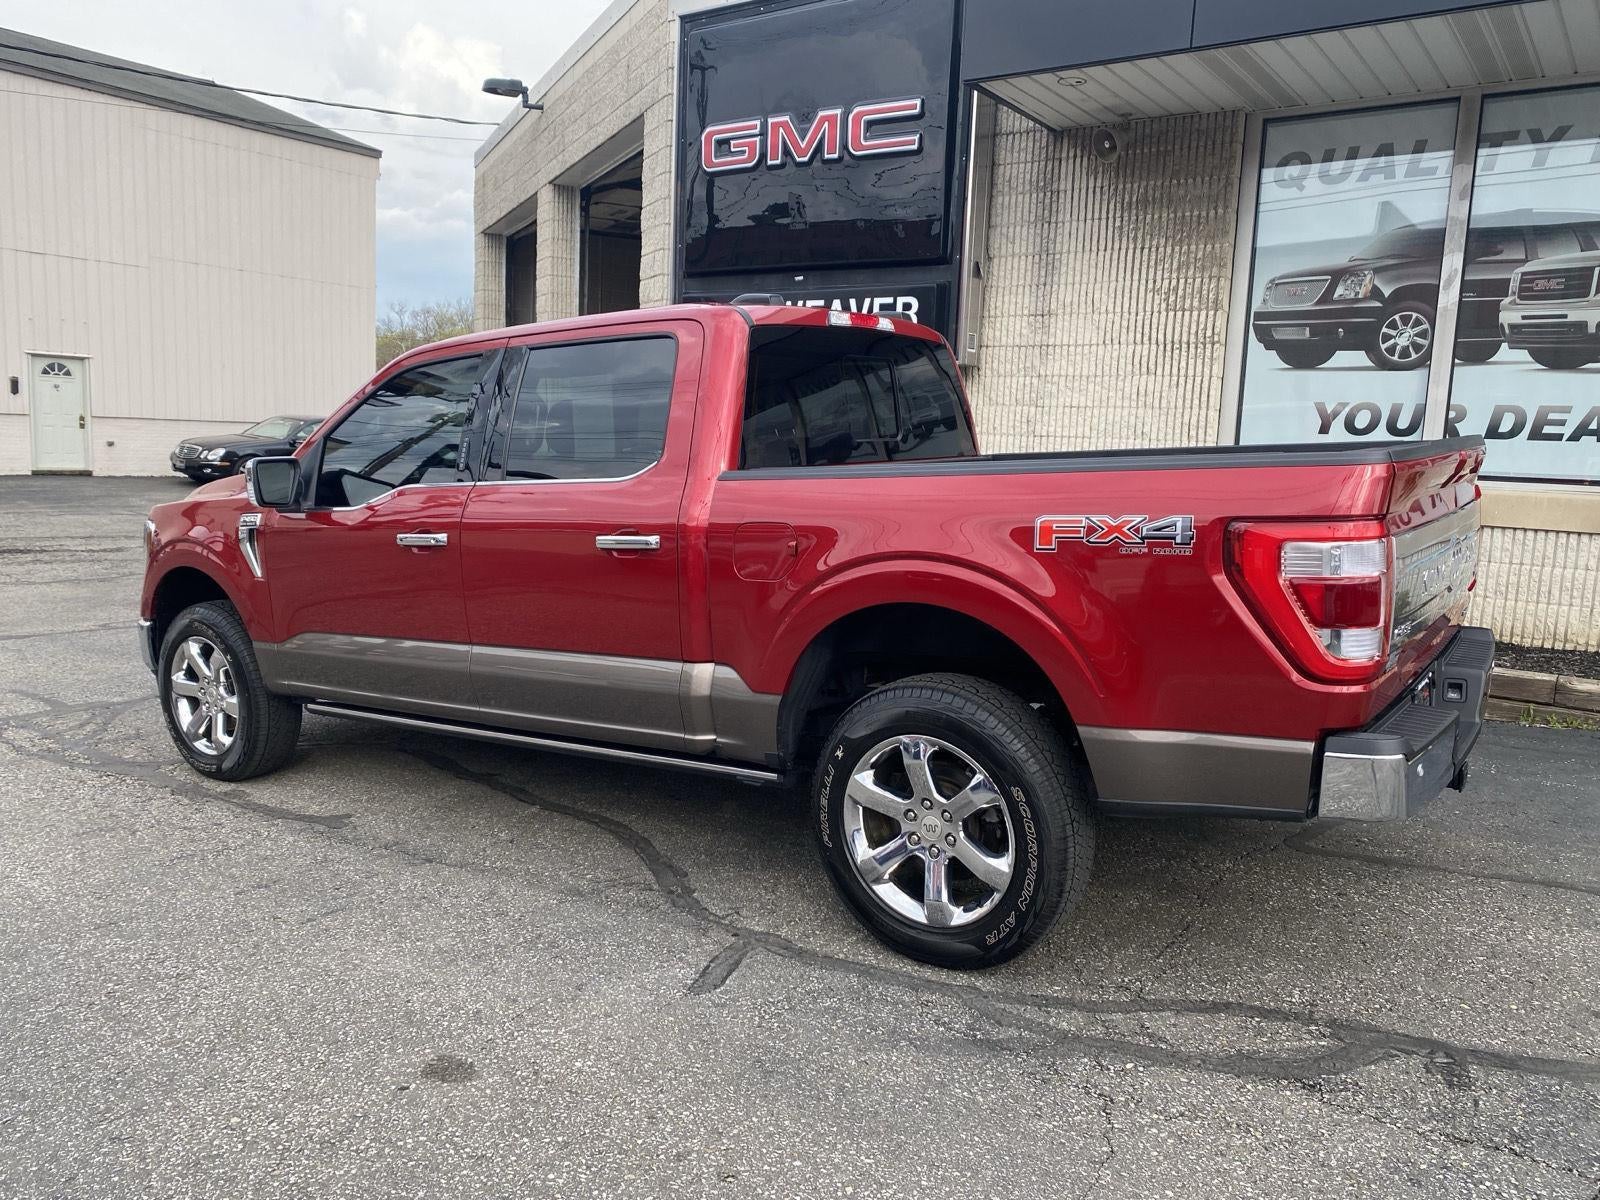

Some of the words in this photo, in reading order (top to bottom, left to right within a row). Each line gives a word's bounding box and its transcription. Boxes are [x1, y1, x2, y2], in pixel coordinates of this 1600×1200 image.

[700, 97, 923, 172] GMC
[1533, 278, 1565, 290] GMC
[1313, 401, 1467, 438] YOUR
[1034, 515, 1196, 552] FX4
[820, 763, 835, 848] PIRELLI
[1010, 786, 1038, 912] SCORPION
[985, 910, 1017, 946] ATR
